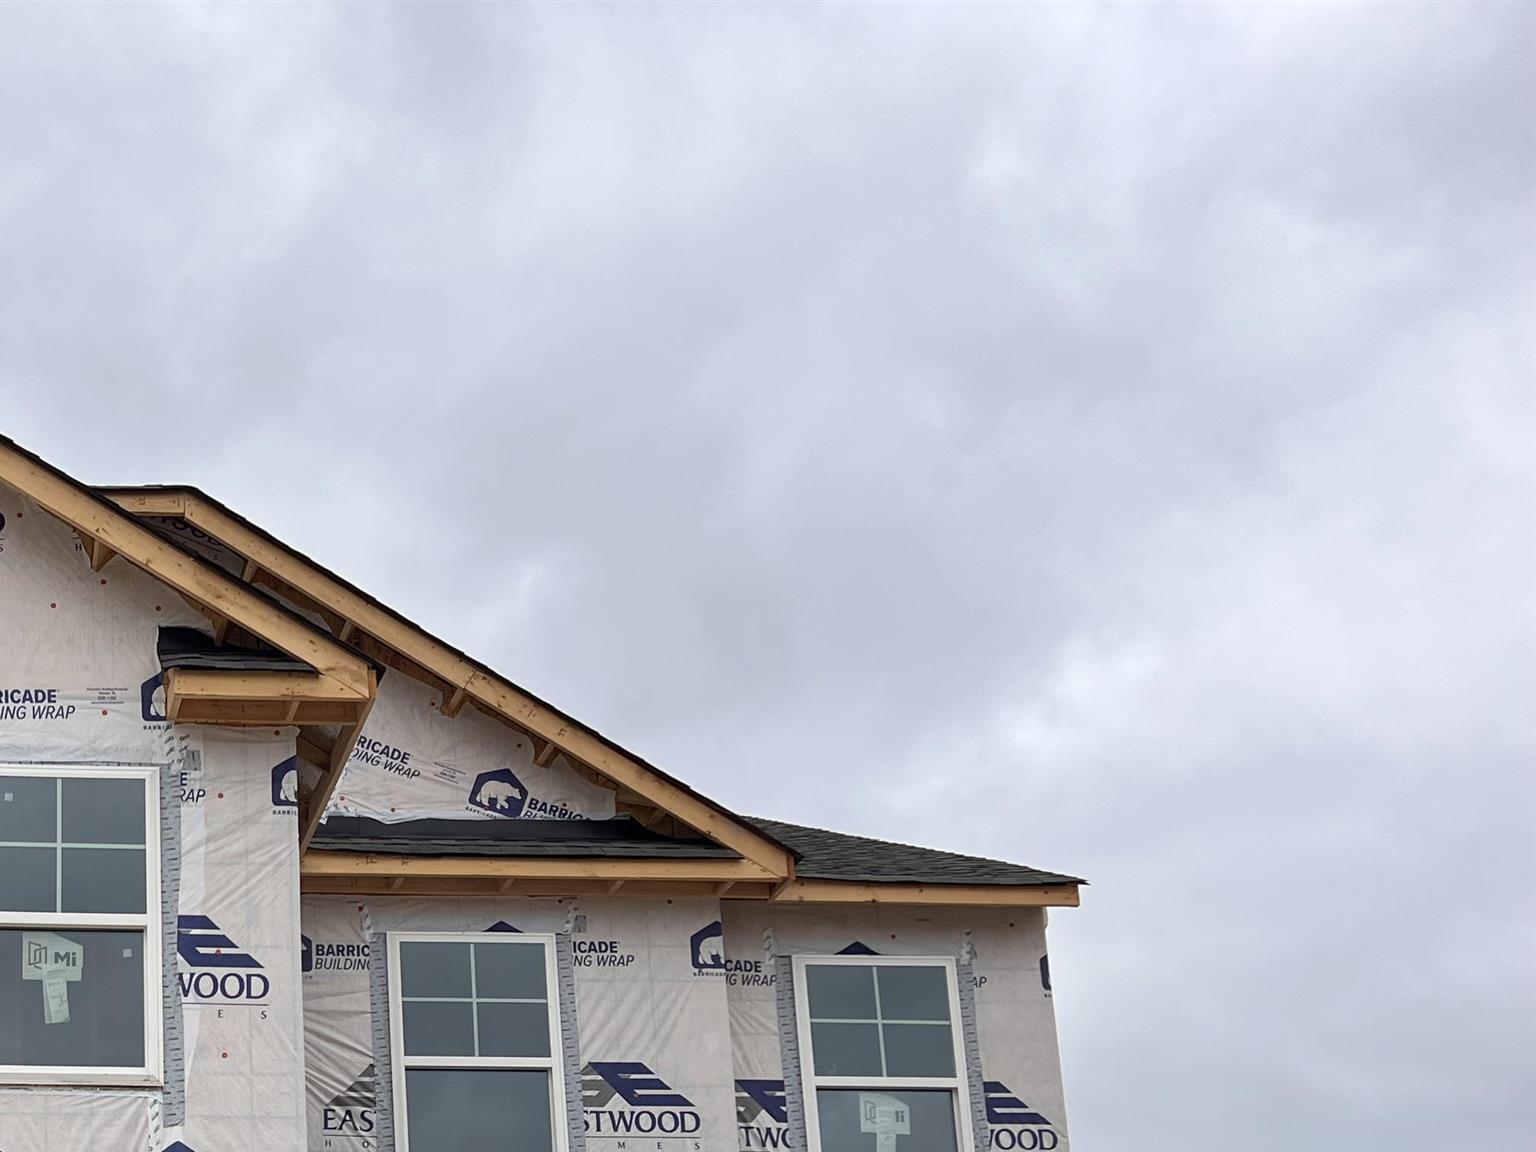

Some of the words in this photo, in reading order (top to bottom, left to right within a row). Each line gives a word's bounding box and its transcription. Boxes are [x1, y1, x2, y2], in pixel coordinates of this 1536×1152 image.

[41, 706, 75, 720] WRAP
[383, 761, 420, 781] WRAP
[573, 942, 618, 954] ICADE
[54, 951, 77, 967] Mi
[596, 955, 635, 966] WRAP
[742, 975, 777, 986] WRAP
